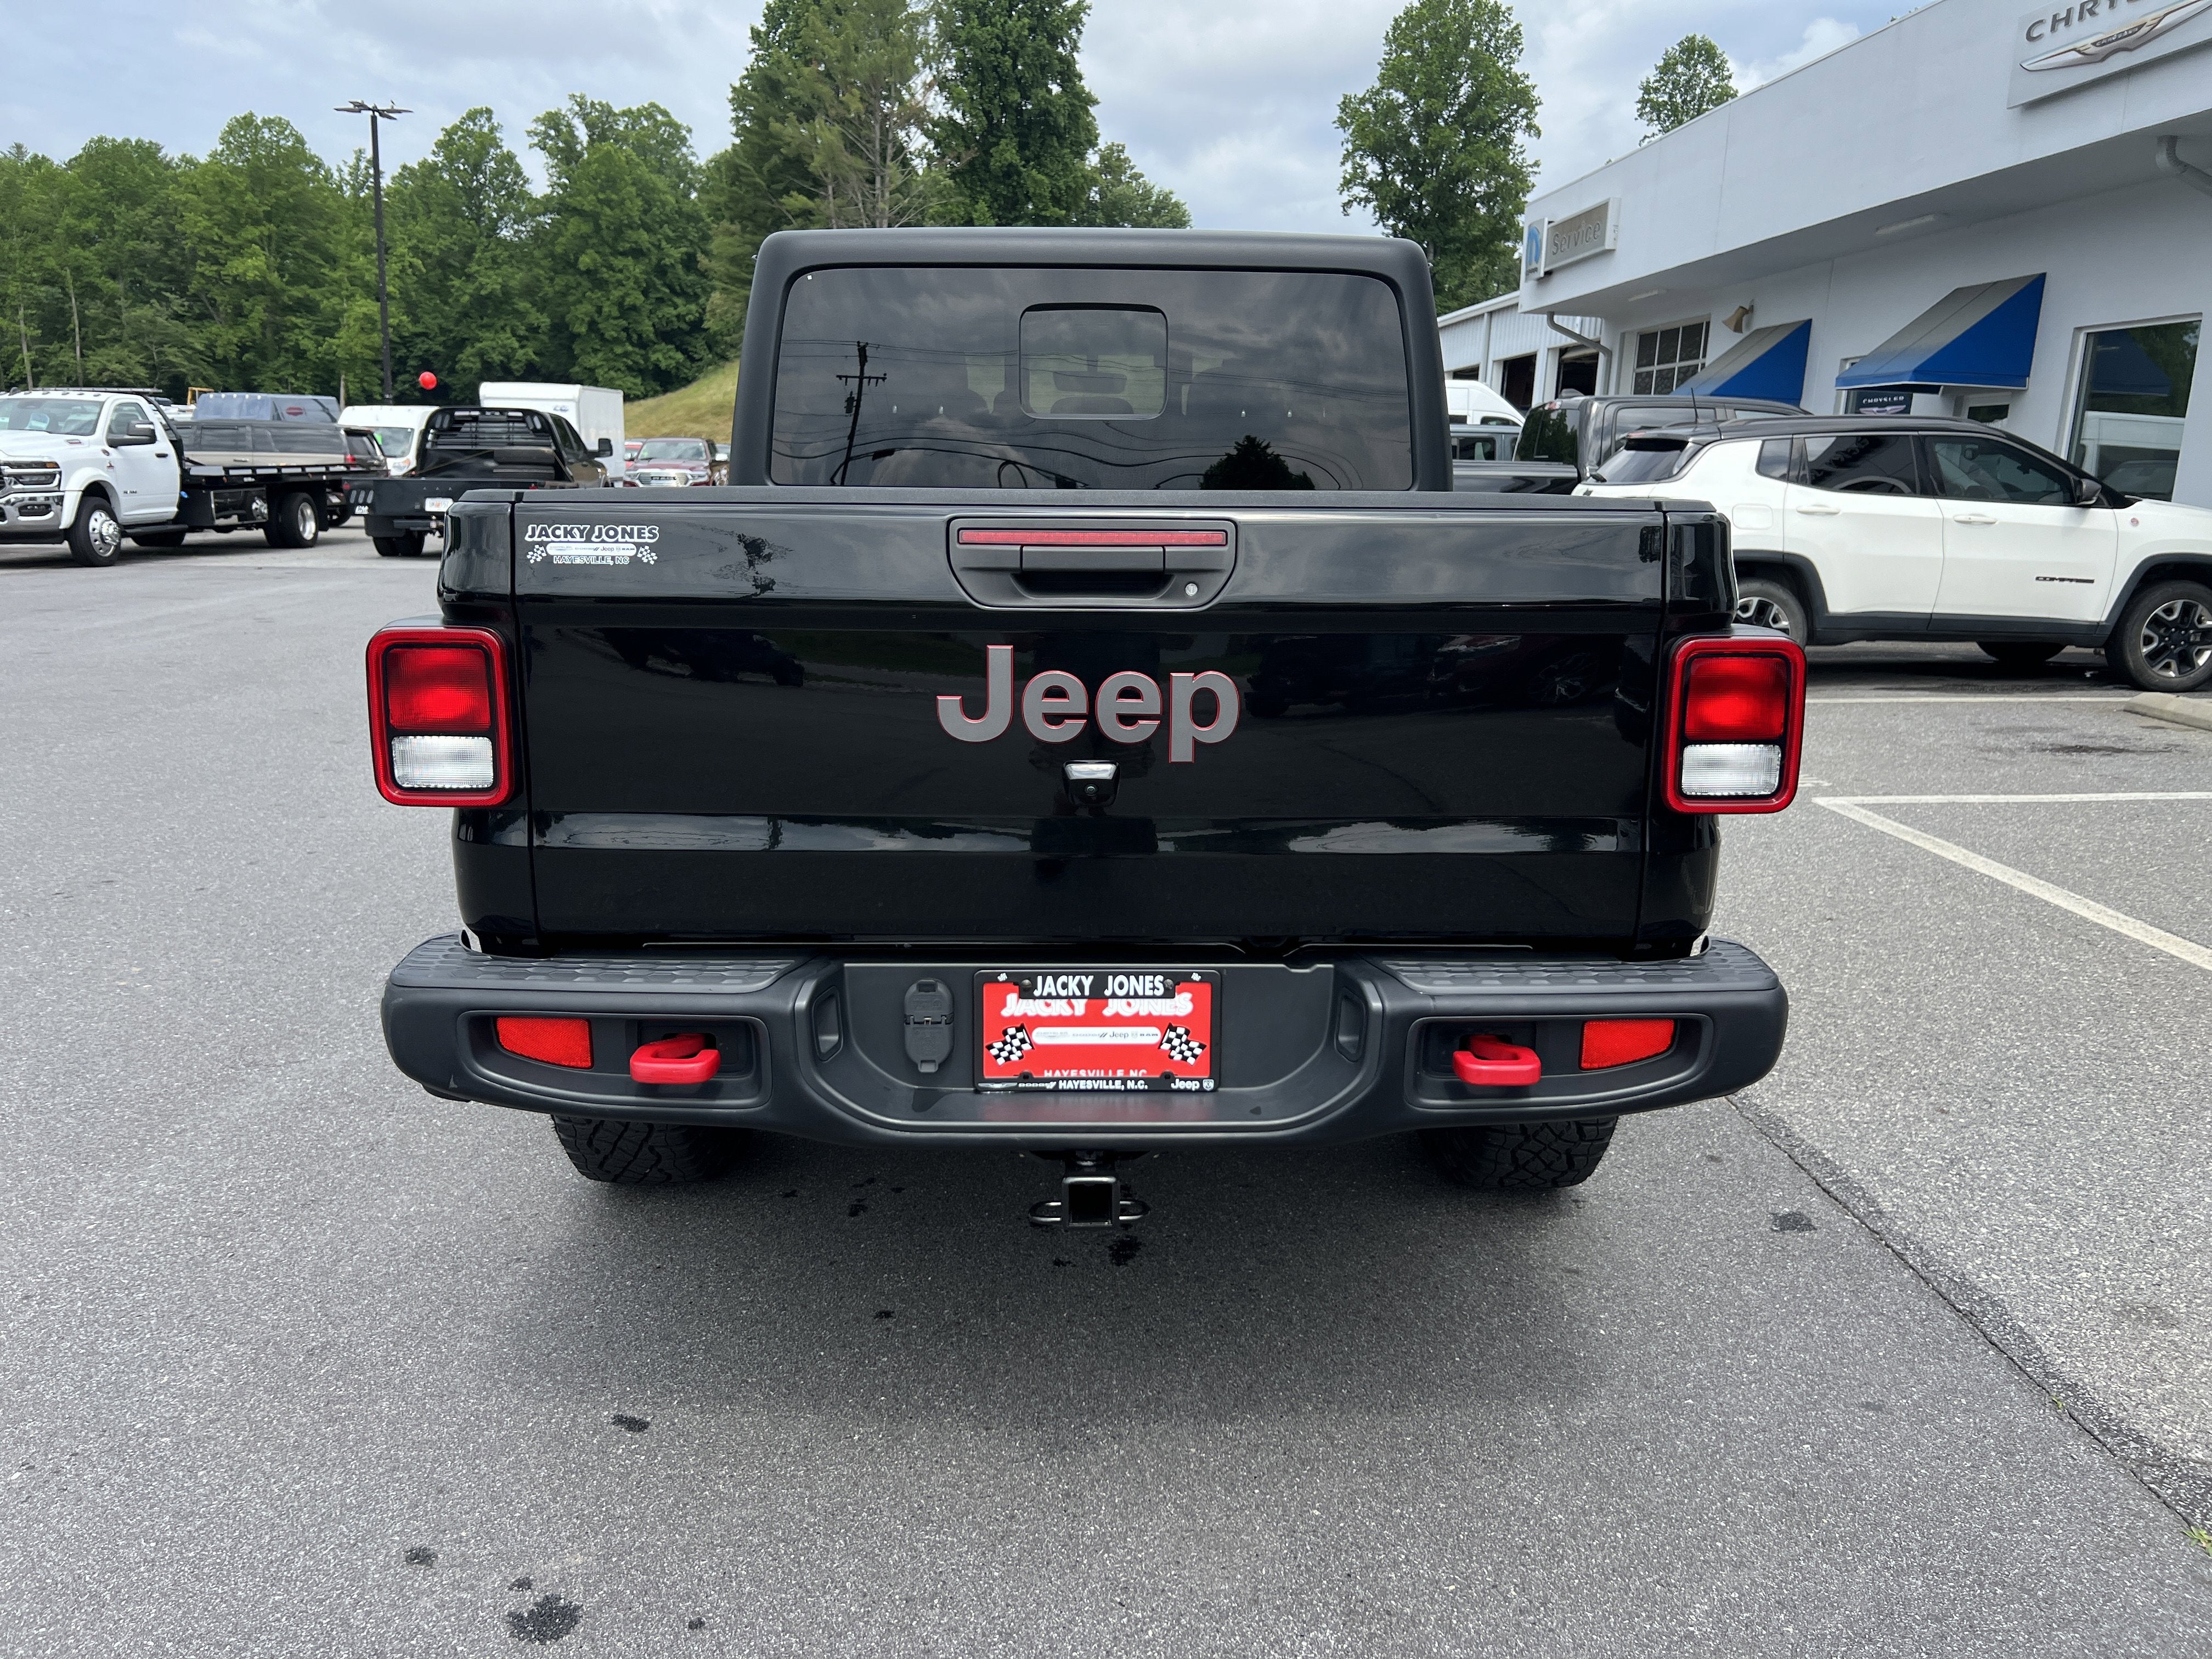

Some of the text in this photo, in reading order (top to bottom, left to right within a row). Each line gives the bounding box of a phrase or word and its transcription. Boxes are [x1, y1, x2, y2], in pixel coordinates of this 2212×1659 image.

[2025, 0, 2137, 42] CHR
[1552, 219, 1601, 255] Service
[525, 524, 659, 543] JACKY JONES
[553, 555, 630, 566] HAYESVILLE, NC
[936, 645, 1241, 764] Jeep
[1034, 974, 1165, 997] JACKY JONES
[1000, 992, 1194, 1017] JACKY JONES
[1058, 1079, 1125, 1090] HAYESVILLE,
[1127, 1080, 1148, 1090] N.C.
[1171, 1078, 1200, 1091] Jeep
